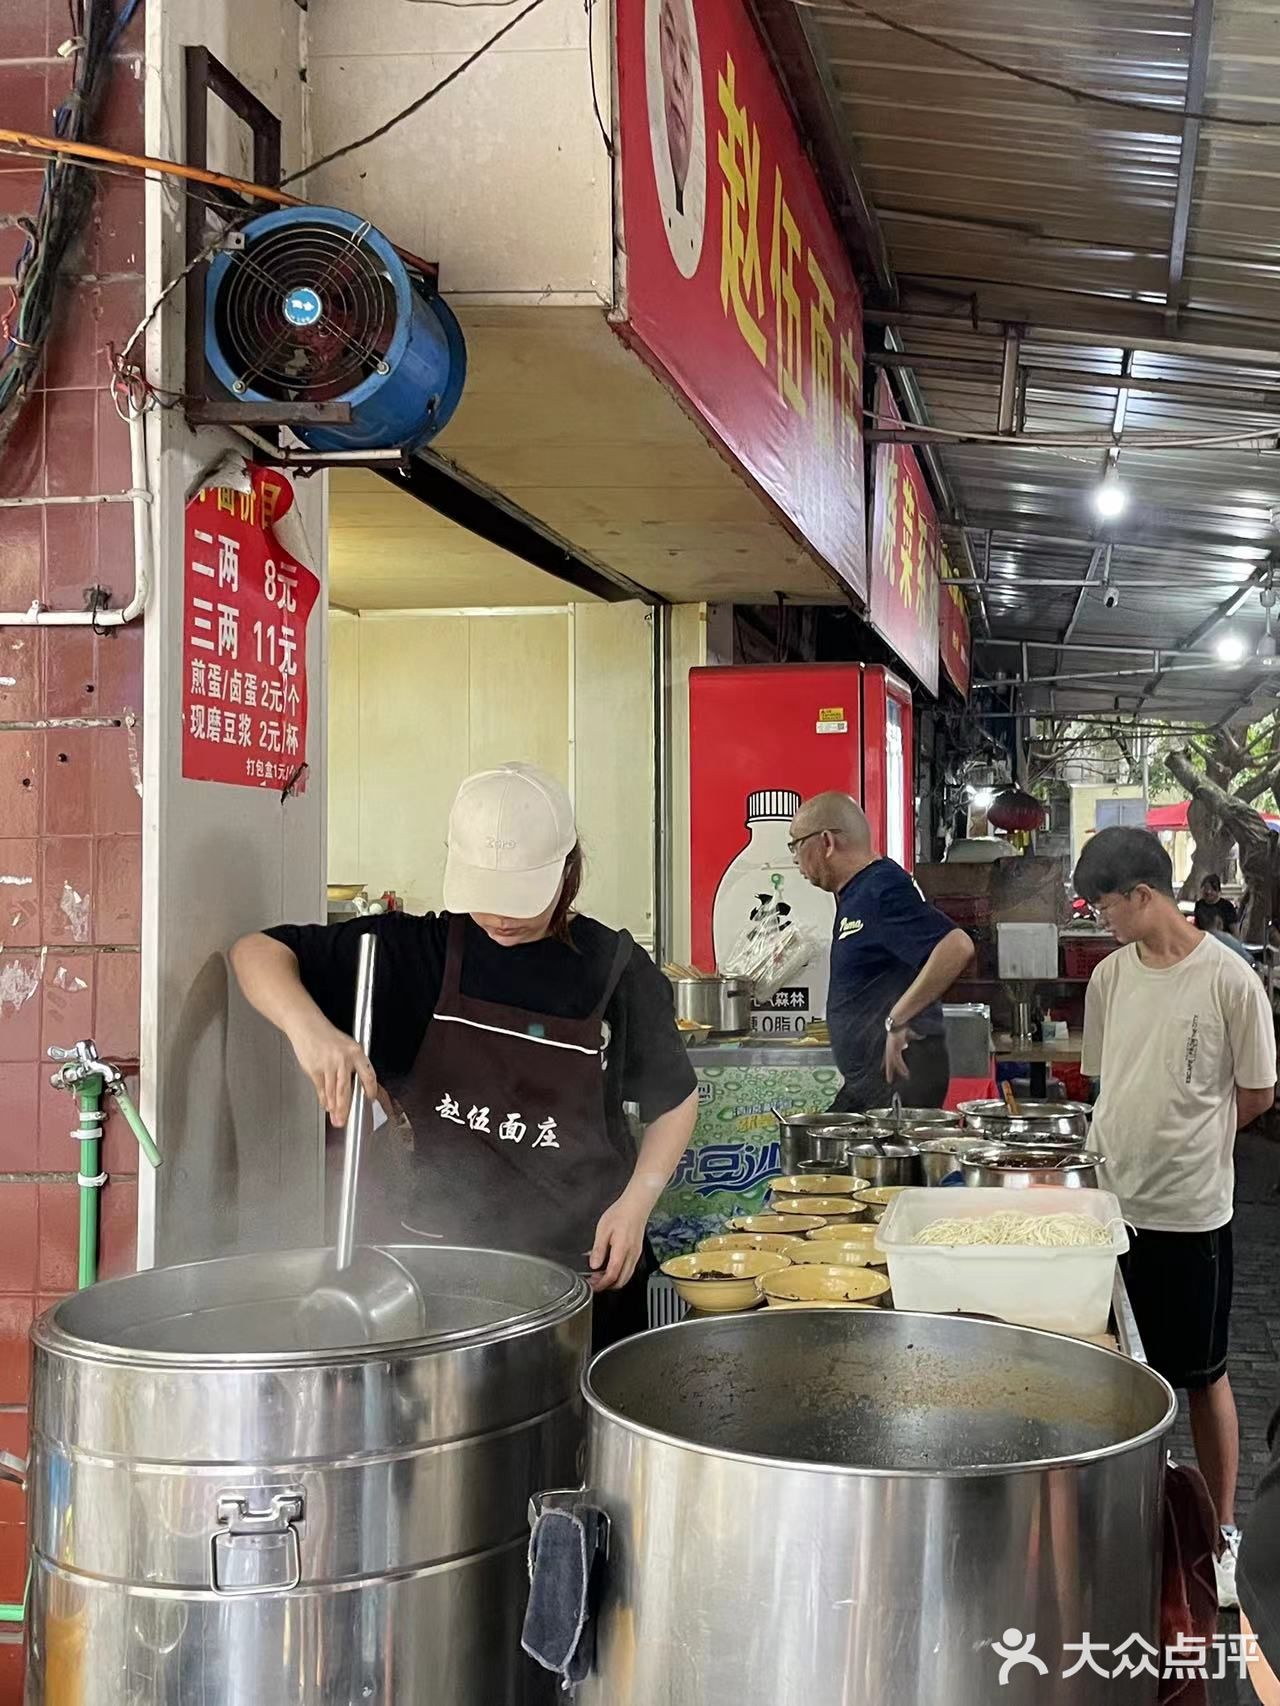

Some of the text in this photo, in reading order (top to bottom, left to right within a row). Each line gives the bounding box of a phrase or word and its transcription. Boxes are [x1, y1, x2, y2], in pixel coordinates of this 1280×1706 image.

[192, 529, 298, 613] 二两 8元
[191, 597, 297, 676] 三两 11元
[191, 658, 257, 707] 煎蛋/卤蛋
[190, 704, 299, 755] 现磨豆浆 2元/杯
[434, 1092, 561, 1149] 赵伍面庄
